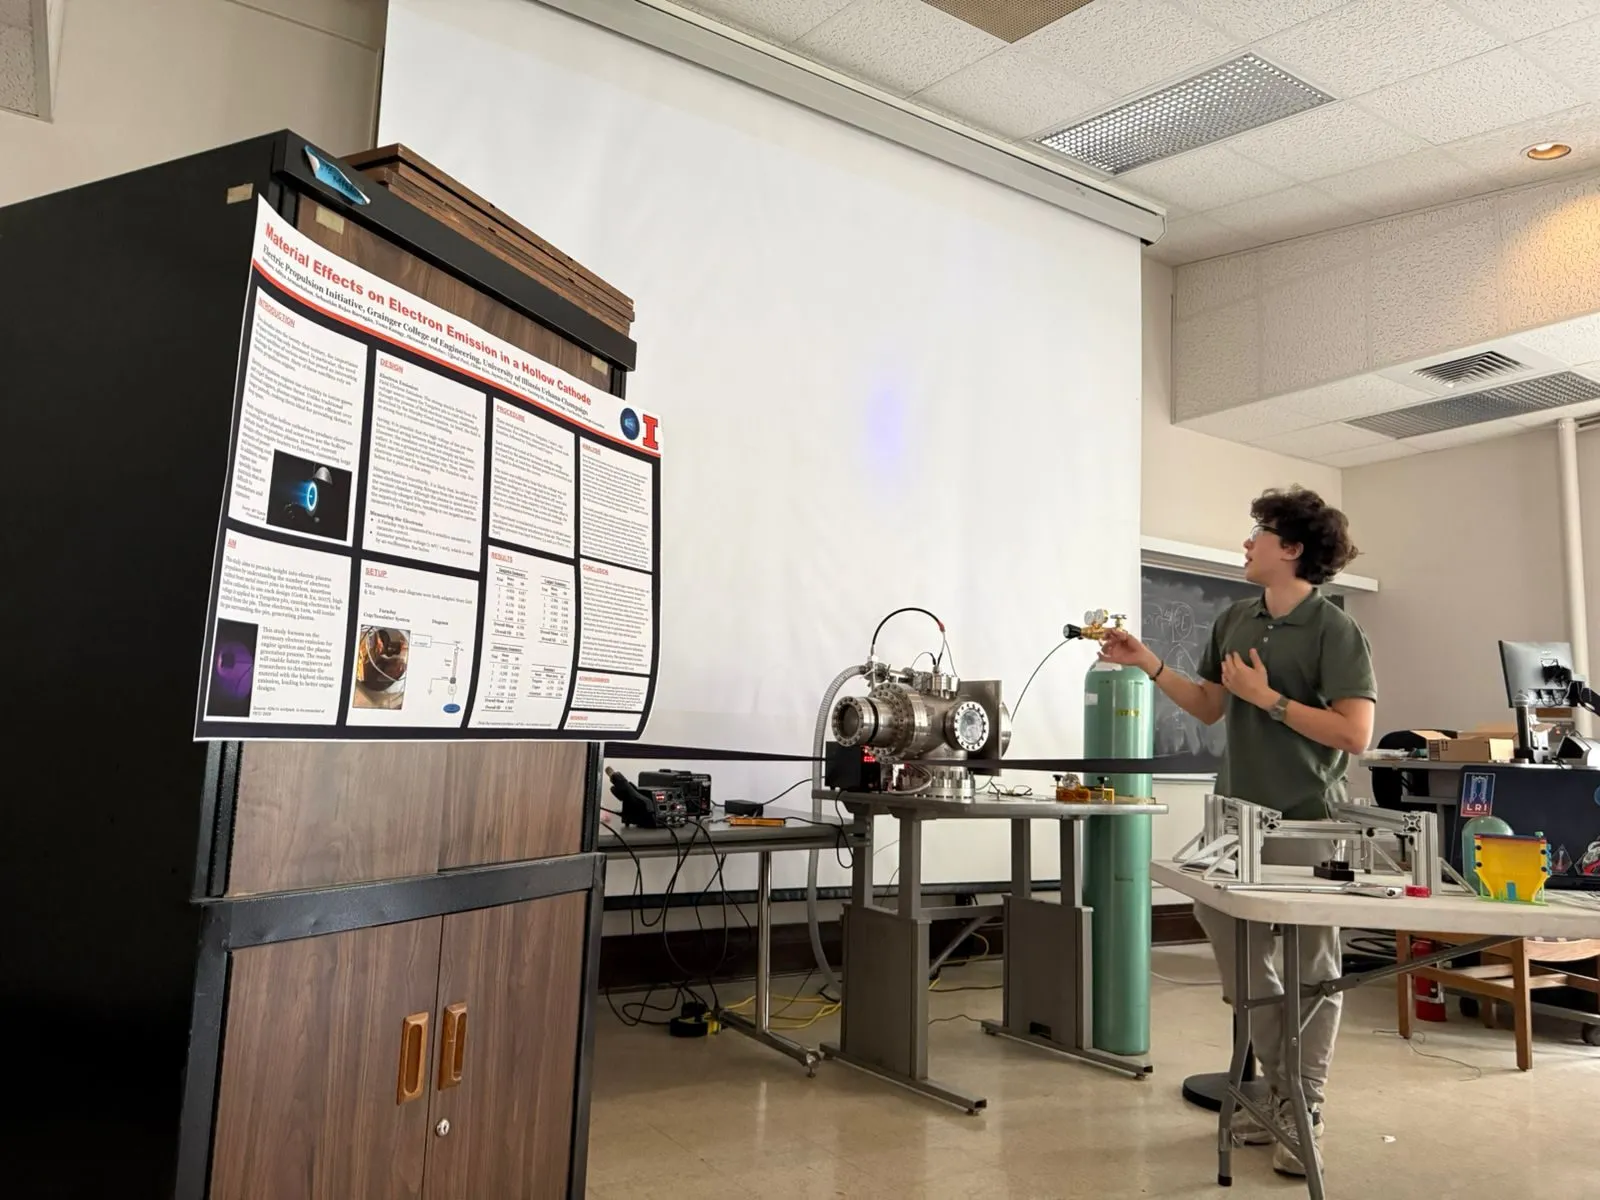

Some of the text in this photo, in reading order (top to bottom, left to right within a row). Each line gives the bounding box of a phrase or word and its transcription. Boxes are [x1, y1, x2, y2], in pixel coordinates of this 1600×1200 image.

[258, 297, 296, 327] INTRODUCTION
[265, 223, 309, 268] Material
[313, 259, 364, 296] Effects
[368, 290, 385, 305] on
[389, 297, 443, 332] Electron
[447, 324, 498, 359] Emission
[500, 351, 510, 364] in
[513, 361, 519, 369] a
[522, 361, 555, 386] Hollow
[557, 379, 592, 406] Cathode
[263, 244, 285, 270] Electric
[285, 263, 324, 295] Propulsion
[326, 287, 366, 313] Initiative,
[367, 306, 402, 329] Grainger
[403, 321, 430, 341] College
[431, 335, 439, 345] of
[440, 338, 481, 365] Engineering,
[482, 358, 514, 380] University
[515, 374, 522, 383] of
[522, 376, 541, 392] Illinois
[542, 386, 561, 402] Urbana
[561, 396, 589, 416] Champaign
[380, 358, 404, 374] DESIGN
[496, 404, 525, 422] PROCEDURE
[491, 552, 513, 563] RESULTS
[366, 567, 388, 578] SETUP
[583, 564, 609, 576] CONCLUSION
[1466, 803, 1488, 811] LRI
